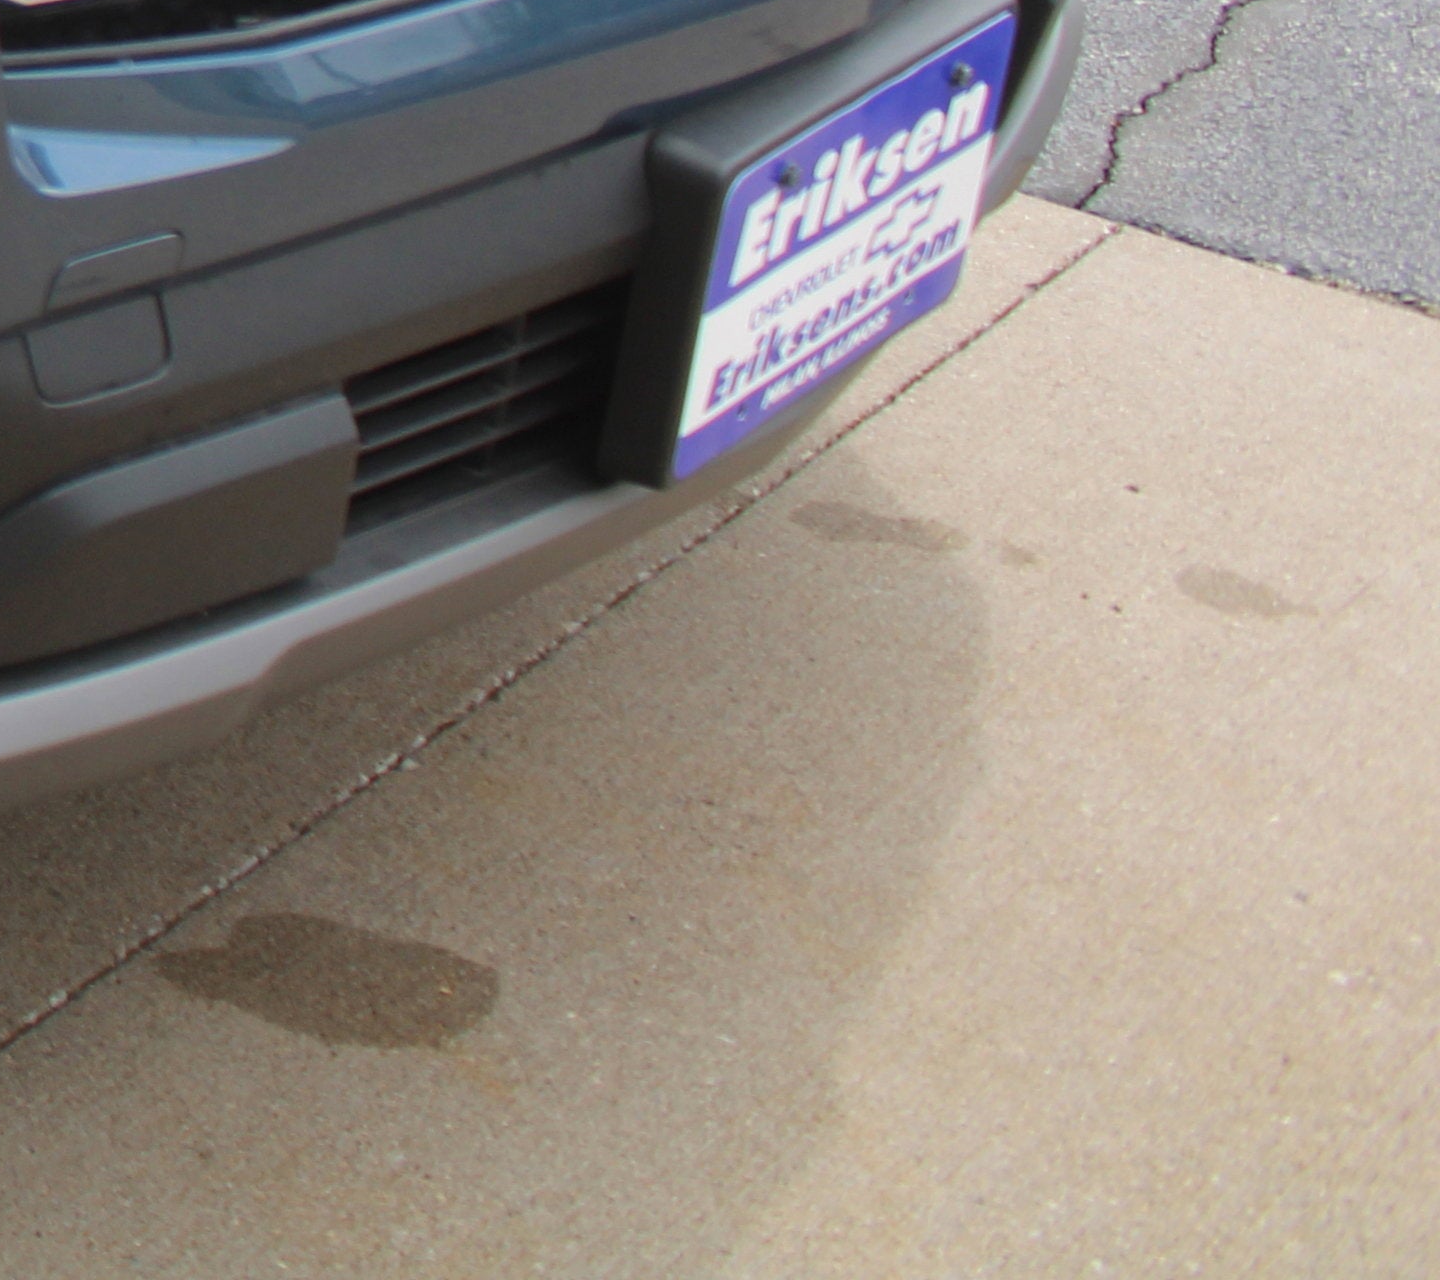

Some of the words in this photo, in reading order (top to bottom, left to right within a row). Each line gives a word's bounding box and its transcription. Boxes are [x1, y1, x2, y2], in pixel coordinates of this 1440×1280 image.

[729, 81, 991, 287] Eriksen
[705, 219, 958, 410] Eriksens.com
[750, 246, 860, 331] CHEVROLET
